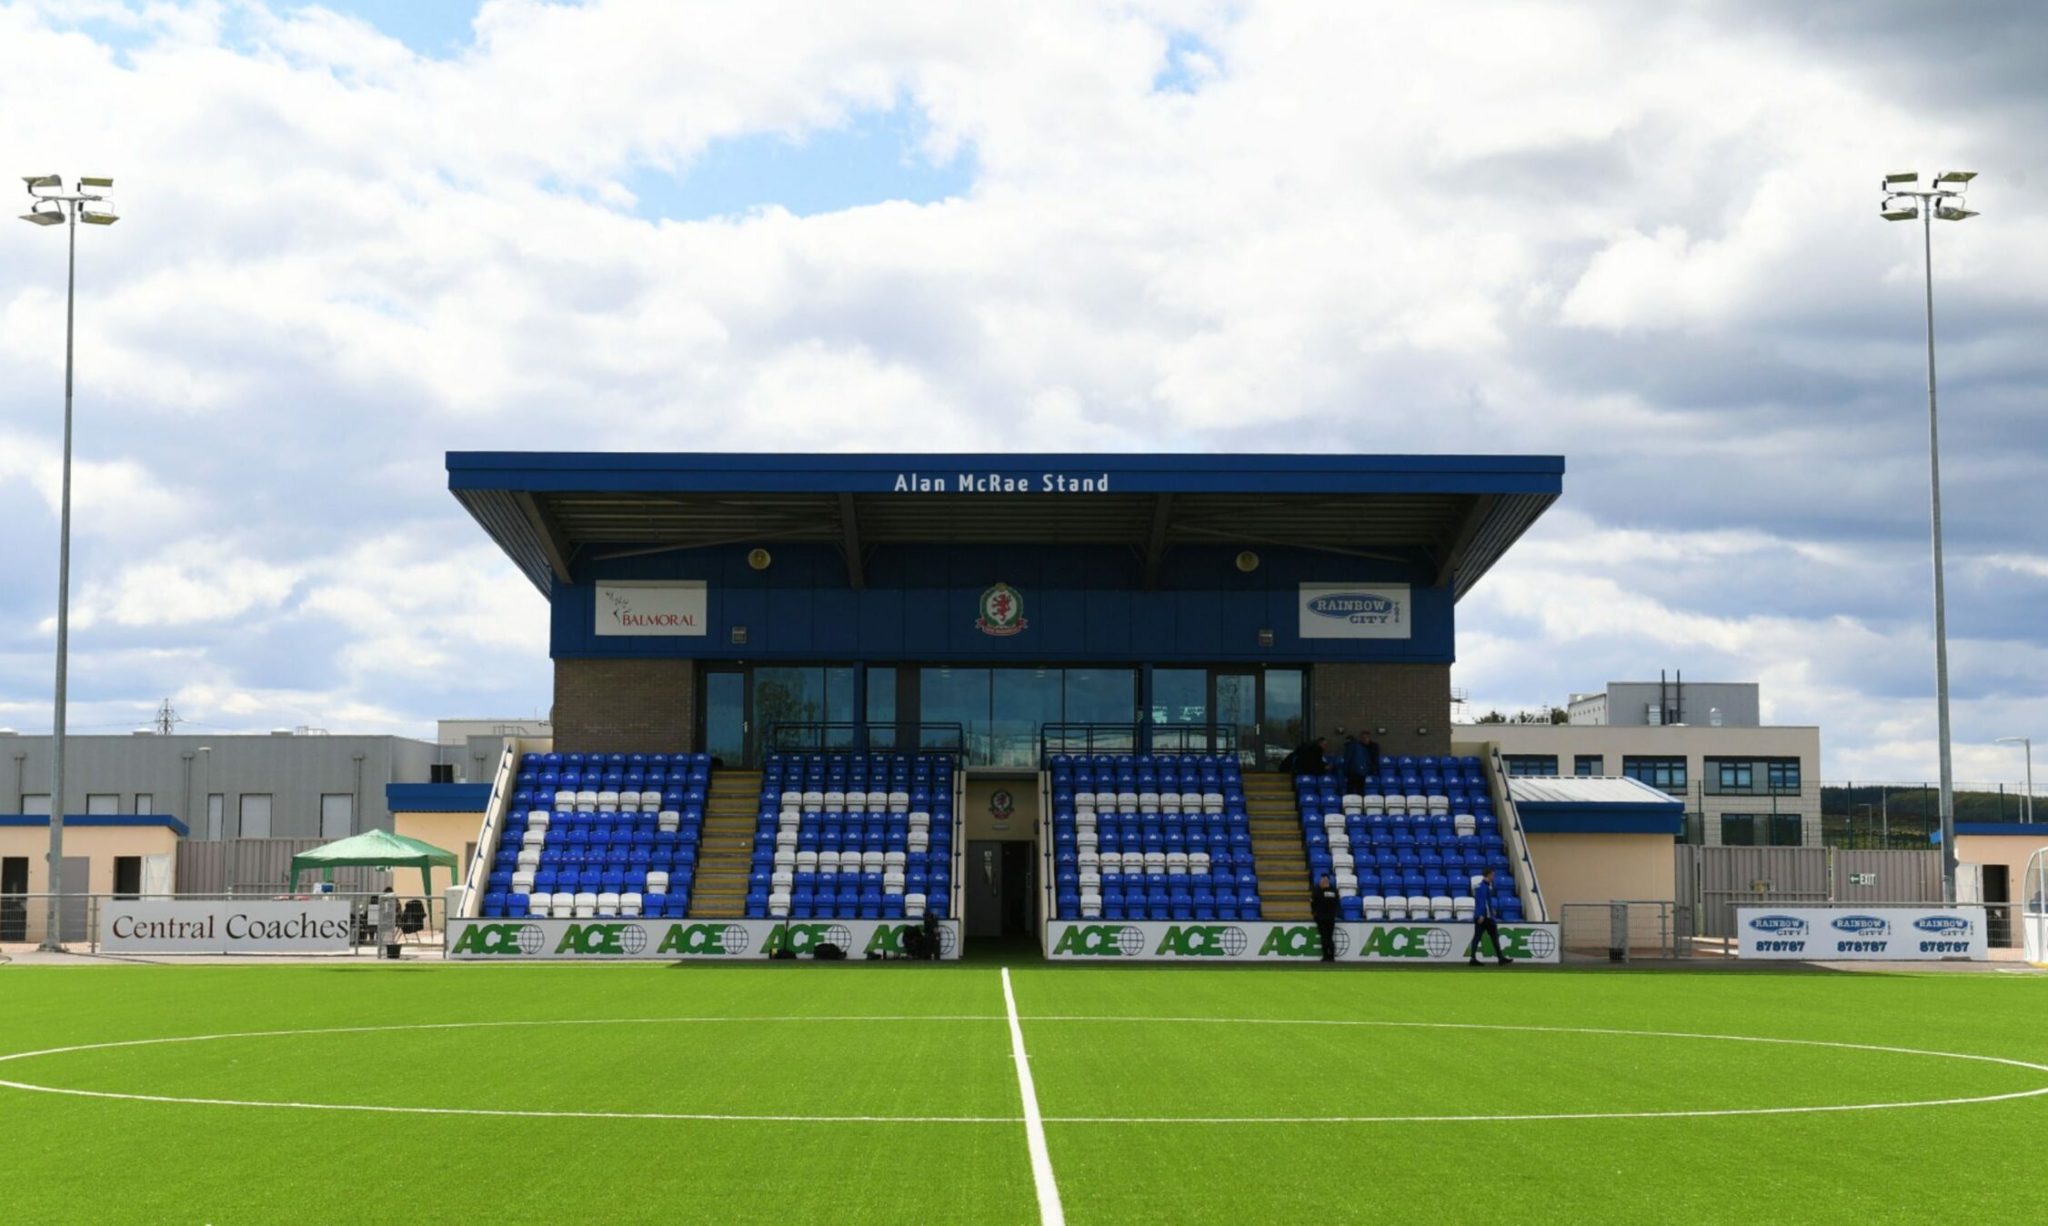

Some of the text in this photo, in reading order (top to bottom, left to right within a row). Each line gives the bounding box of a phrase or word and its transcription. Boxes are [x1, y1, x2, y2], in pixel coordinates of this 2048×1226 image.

[894, 474, 1109, 492] Alan McRae Stand
[1317, 599, 1385, 611] RAINBOW
[622, 614, 696, 626] BALMORAL
[1349, 615, 1388, 624] CITY
[1860, 873, 1876, 886] EXIT
[112, 912, 349, 940] Central Coaches
[1755, 919, 1801, 928] RAINBOW
[1837, 919, 1881, 928] RAINBOW
[1919, 919, 1964, 928] RAINBOW
[452, 923, 522, 954] ACE
[554, 923, 625, 954] ACE
[656, 923, 727, 954] ACE
[1053, 925, 1124, 956] ACE
[1155, 925, 1226, 956] ACE
[1360, 926, 1434, 957] ACE
[1756, 941, 1805, 952] 878787
[1837, 941, 1887, 952] 878787
[1919, 941, 1969, 952] 878787
